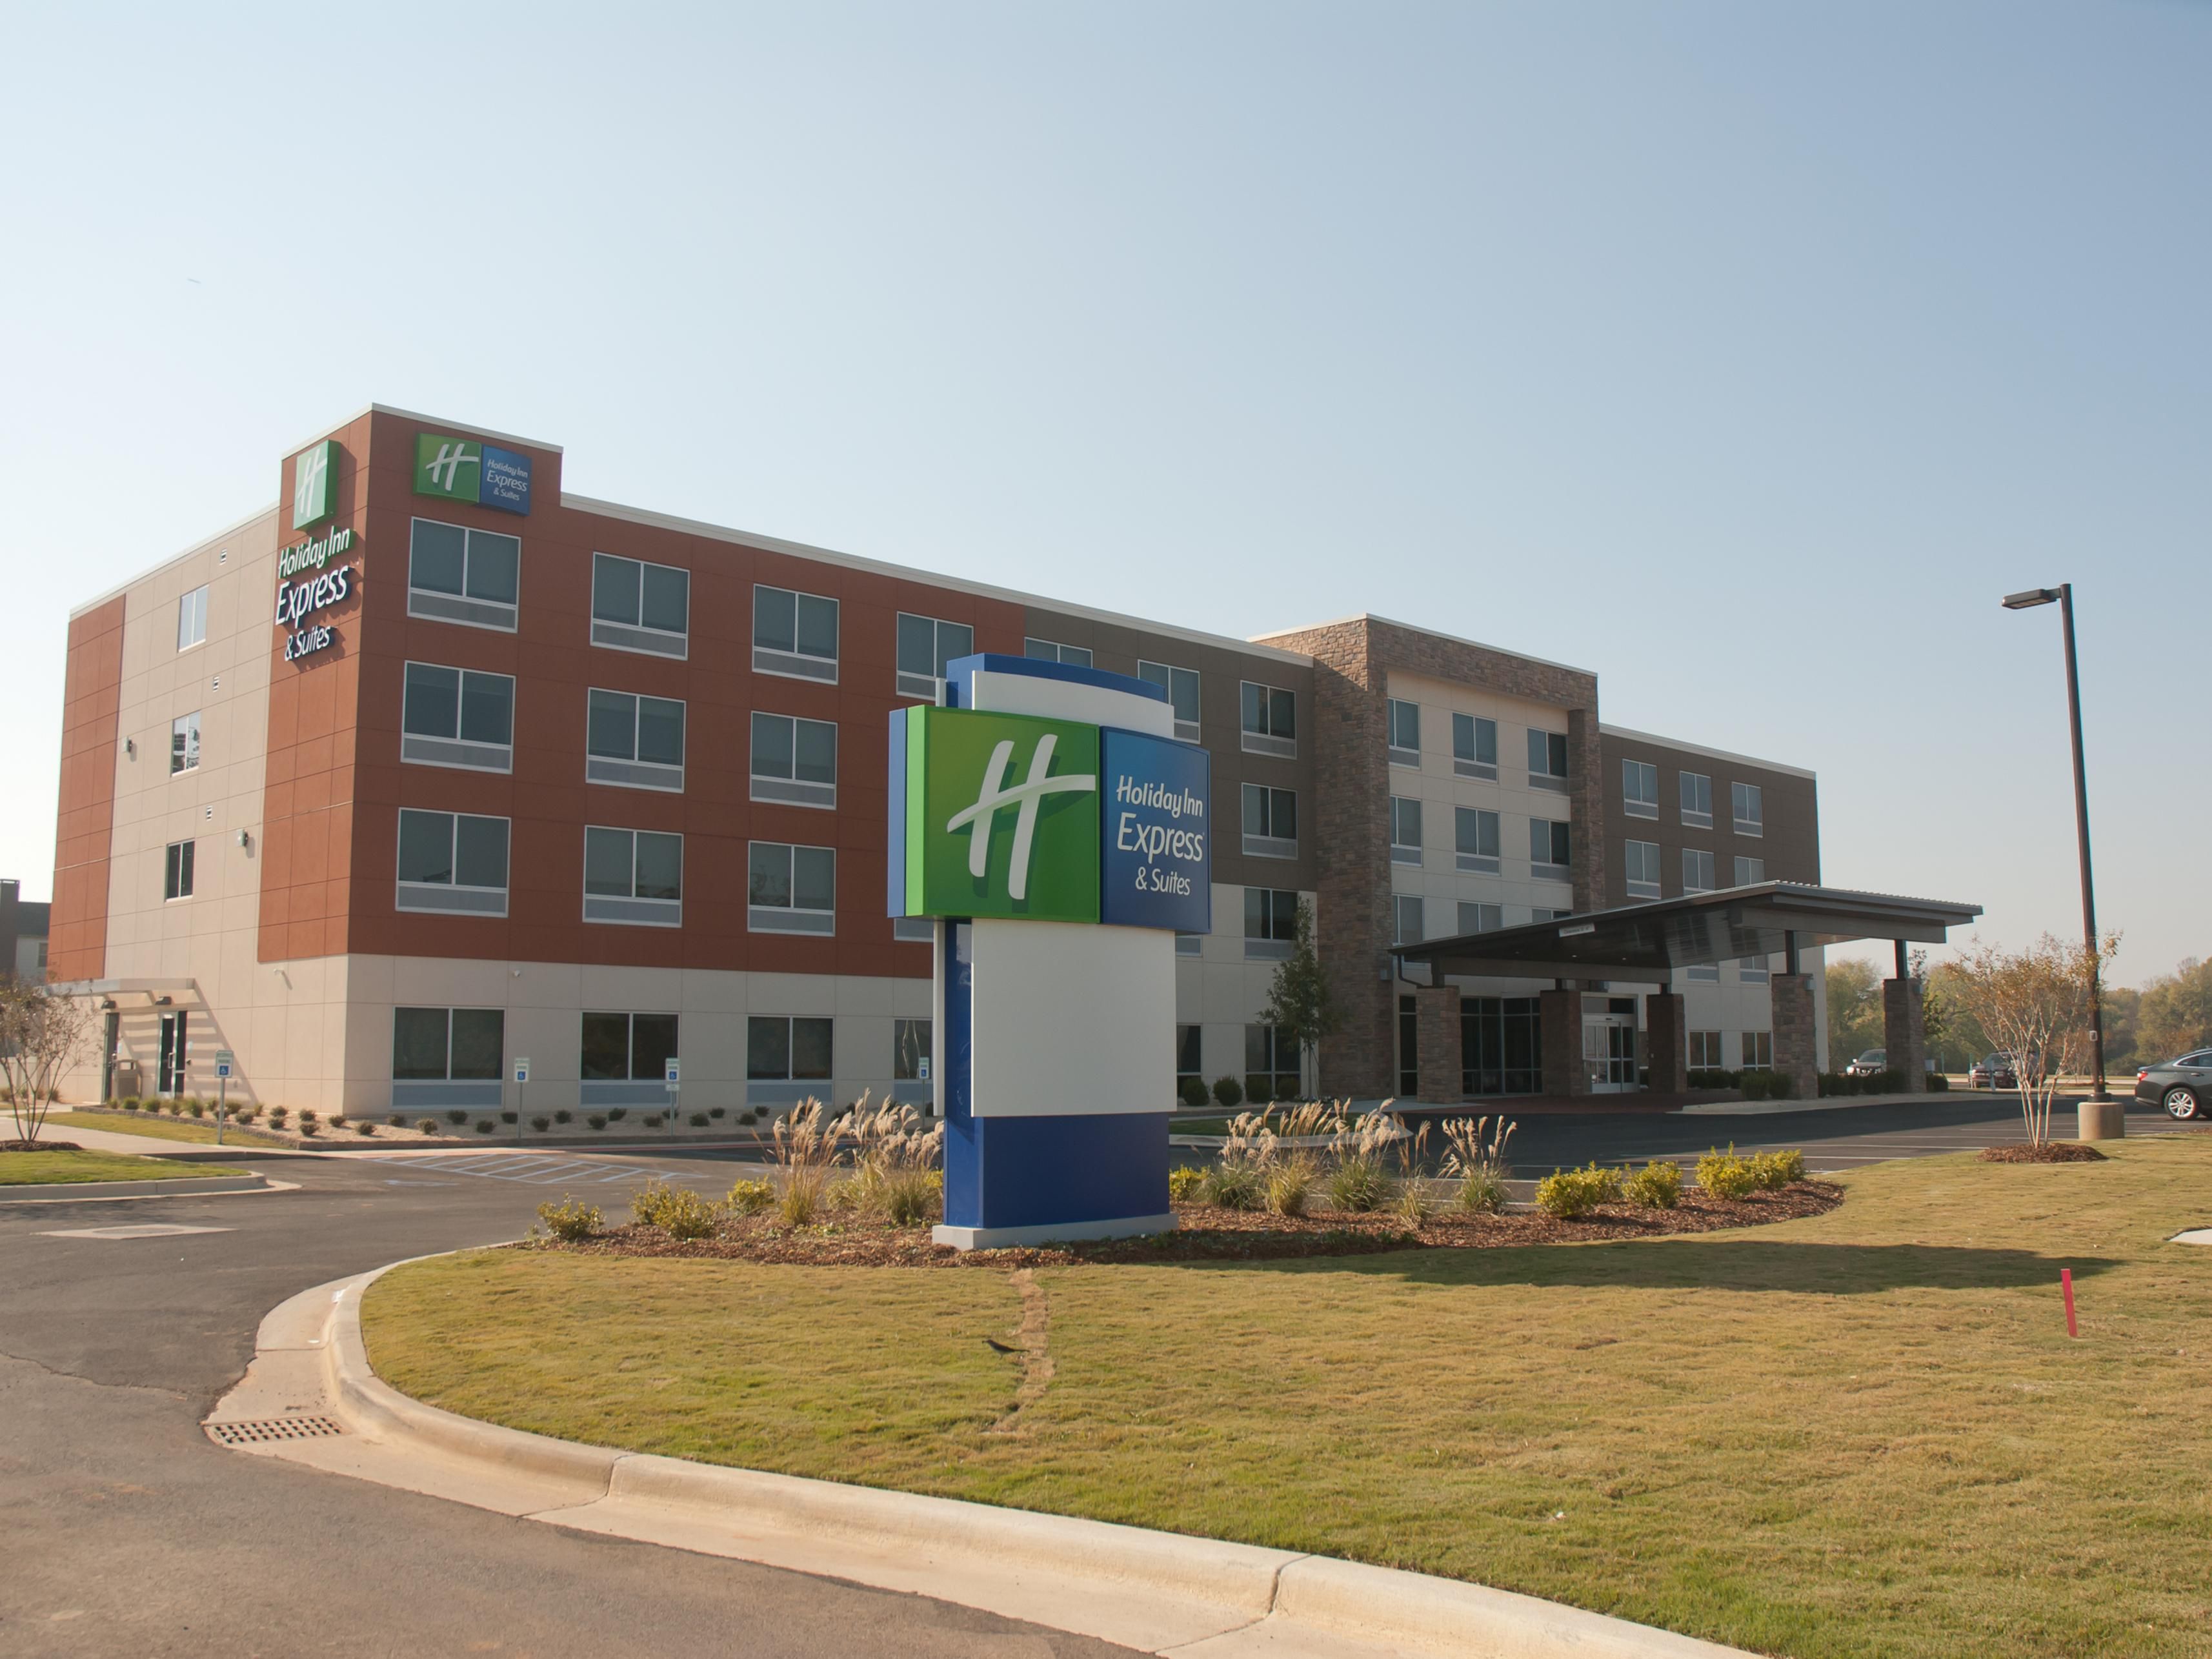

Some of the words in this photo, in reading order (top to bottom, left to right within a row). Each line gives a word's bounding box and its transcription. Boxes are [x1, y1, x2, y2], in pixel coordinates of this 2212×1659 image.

[487, 459, 517, 476] Holiday
[517, 467, 528, 478] Inn
[487, 470, 527, 492] Express
[500, 488, 520, 501] Suites
[279, 536, 327, 579] Holiday
[328, 525, 350, 557] Inn
[276, 565, 348, 629] Express
[285, 634, 294, 661] &
[294, 625, 331, 658] Suites
[1116, 775, 1182, 818] Holiday
[1183, 788, 1203, 817] Inn
[1117, 812, 1204, 864] Express
[1135, 867, 1147, 890] &
[1151, 869, 1191, 896] Suites
